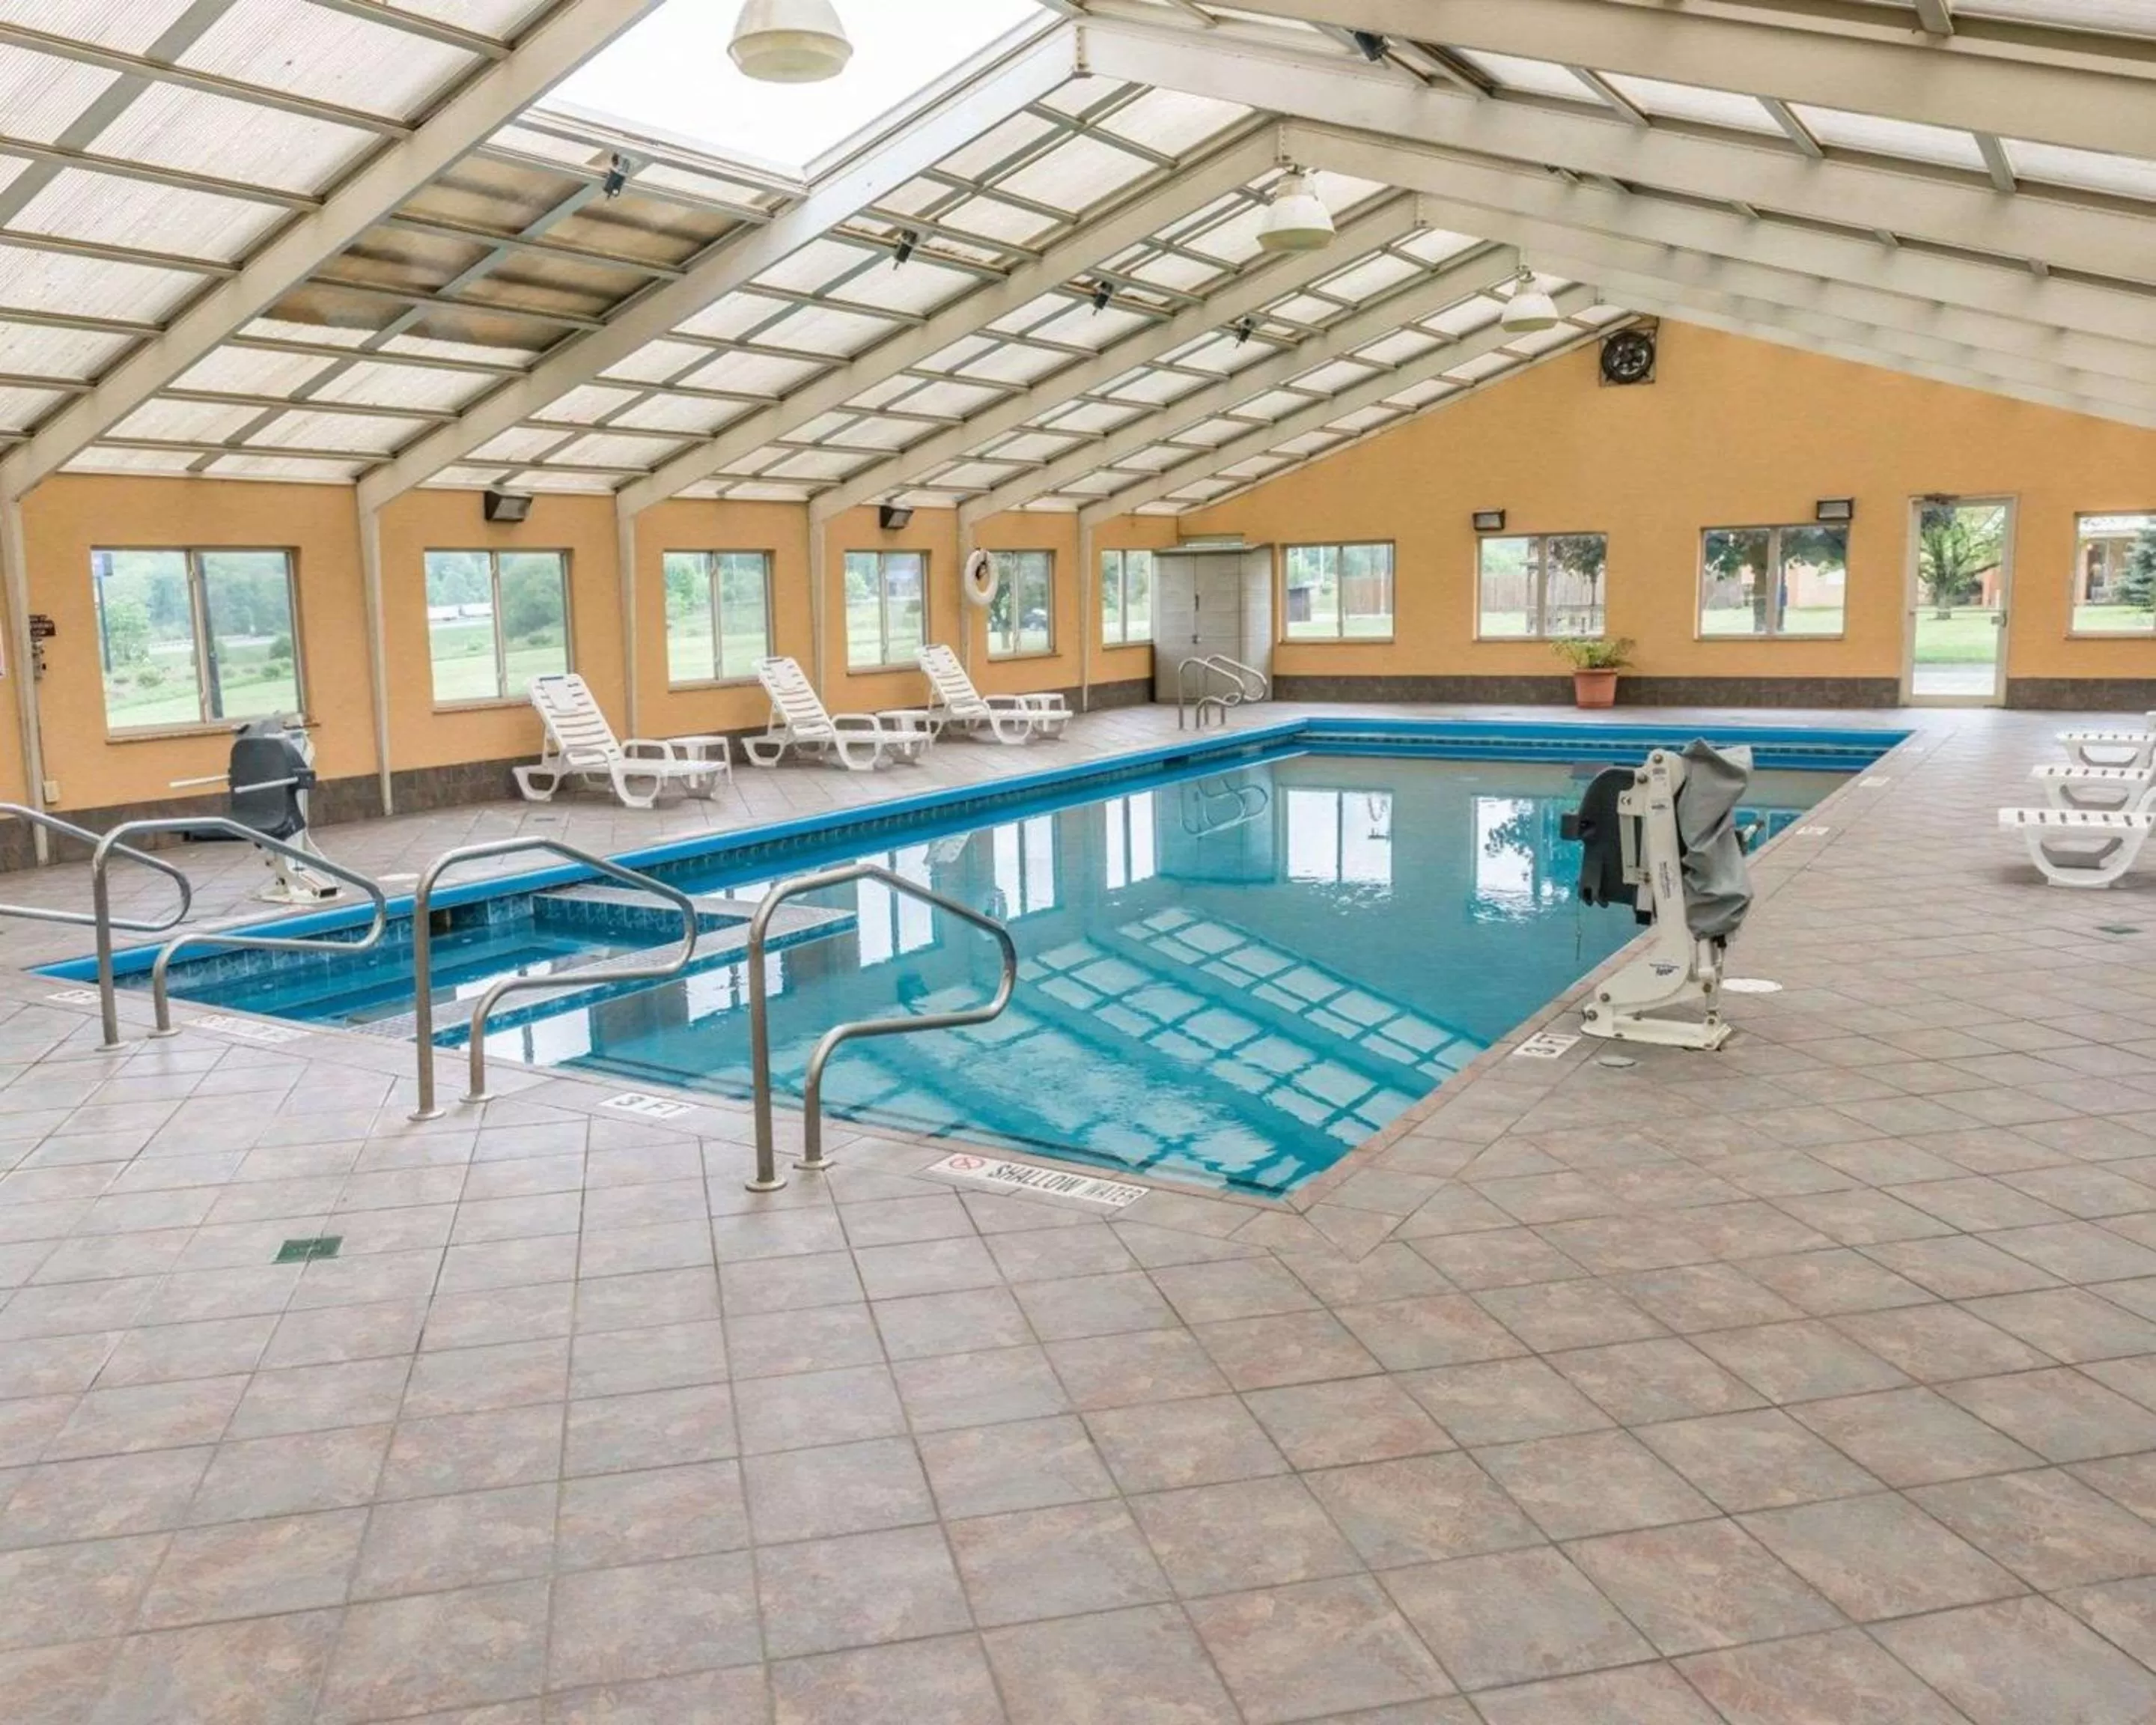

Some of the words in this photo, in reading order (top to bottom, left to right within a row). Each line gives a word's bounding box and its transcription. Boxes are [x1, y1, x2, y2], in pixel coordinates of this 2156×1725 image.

[614, 1095, 646, 1106] 3
[642, 1102, 692, 1115] FT
[987, 1164, 1088, 1193] SHALLOW
